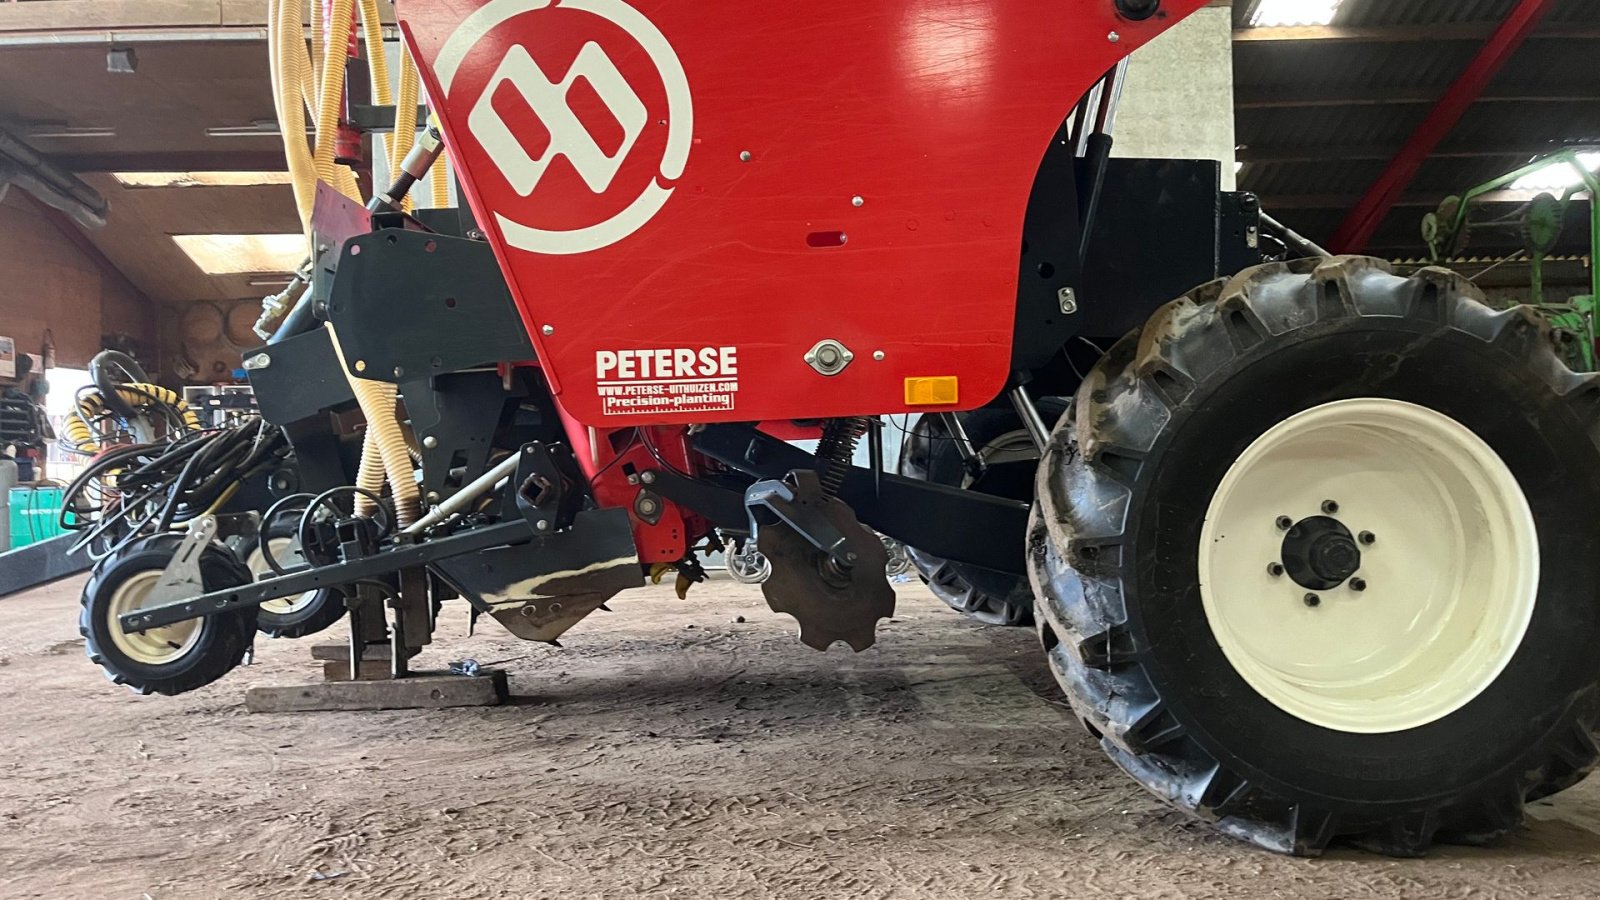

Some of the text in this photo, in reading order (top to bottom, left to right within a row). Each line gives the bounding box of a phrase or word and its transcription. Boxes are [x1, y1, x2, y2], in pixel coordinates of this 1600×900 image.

[596, 346, 738, 379] PETERSE
[597, 382, 738, 396] WWW.PETERSE-UITHUIZEN.COM
[607, 393, 730, 407] Precision-planting
